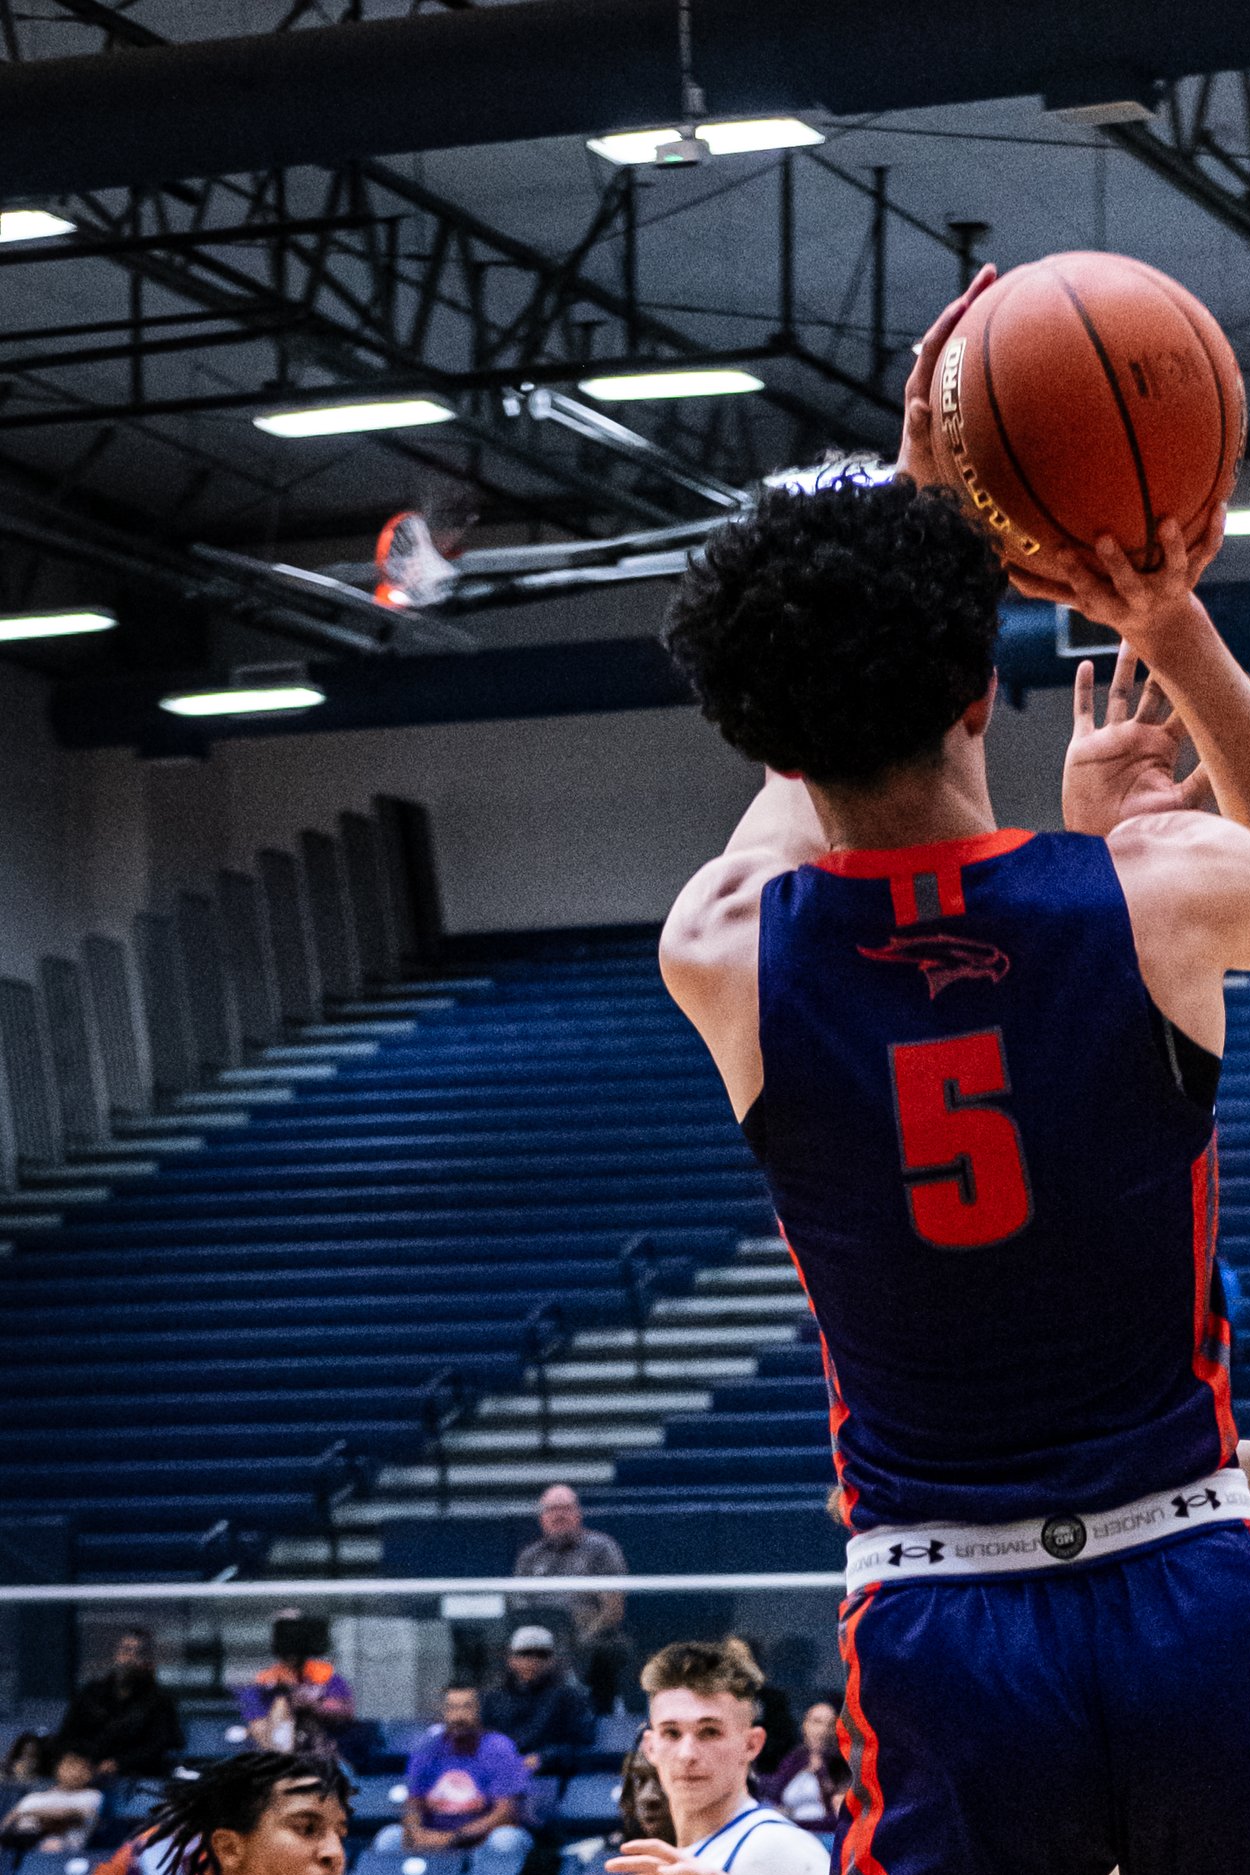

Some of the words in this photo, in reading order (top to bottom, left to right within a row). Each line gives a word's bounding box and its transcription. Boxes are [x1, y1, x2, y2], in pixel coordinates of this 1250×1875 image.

[942, 340, 962, 414] PRO
[887, 1025, 1035, 1250] 5
[954, 1537, 1043, 1558] RMOUR
[1093, 1508, 1166, 1540] UNDER
